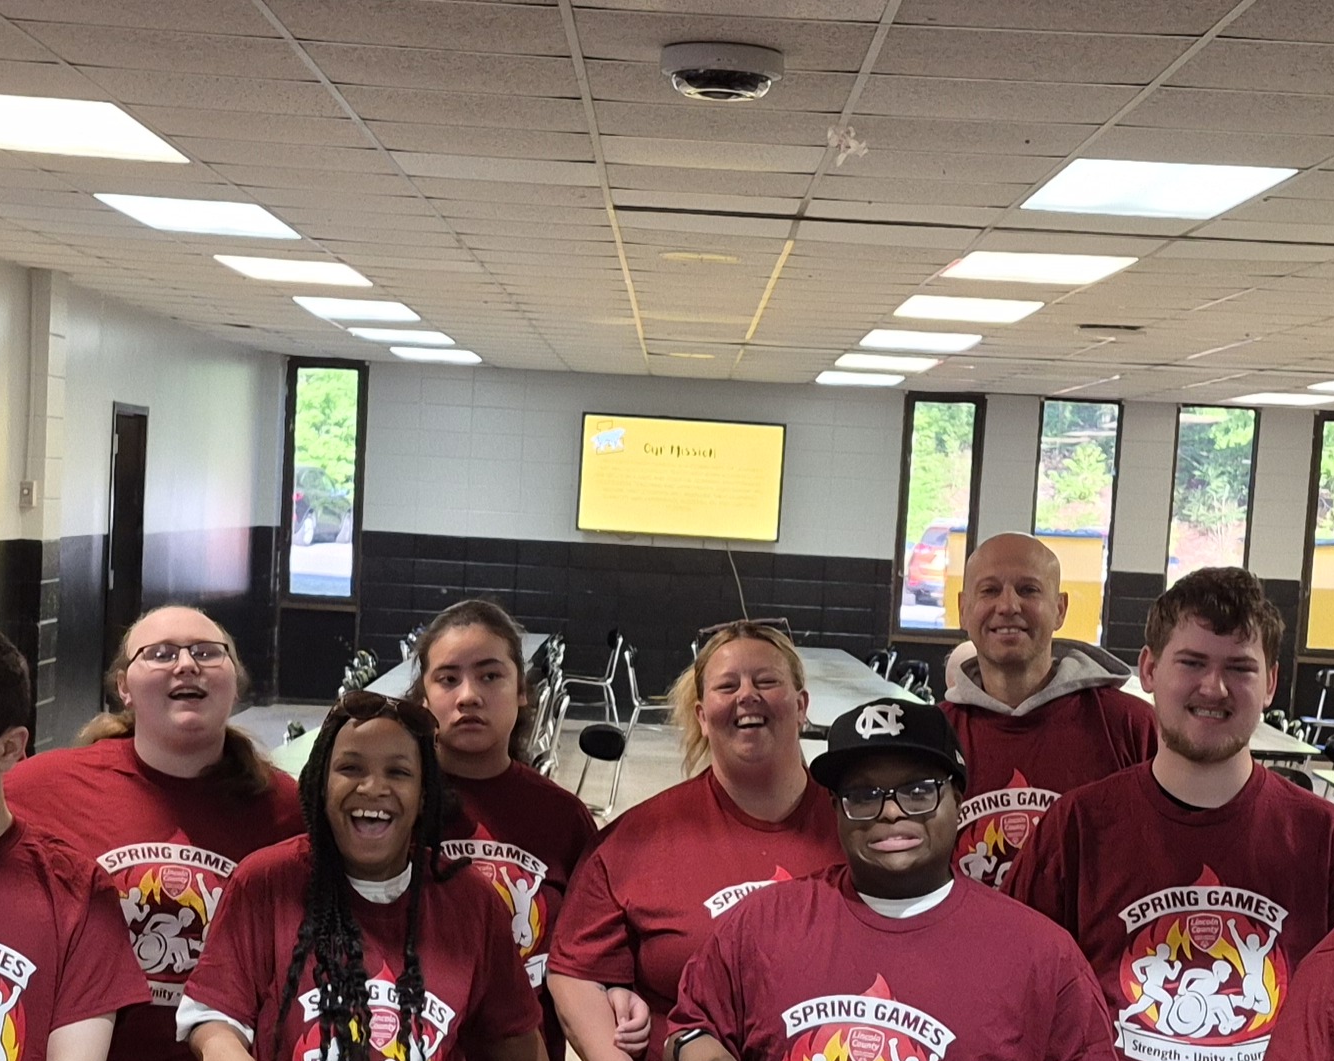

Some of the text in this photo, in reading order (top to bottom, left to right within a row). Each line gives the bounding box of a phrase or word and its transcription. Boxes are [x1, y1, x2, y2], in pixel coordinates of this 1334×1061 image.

[644, 442, 717, 459] Our Mission
[1017, 791, 1055, 808] GAM
[105, 846, 233, 874] SPRING GAME
[441, 842, 476, 857] ING
[482, 843, 541, 872] GAMES
[712, 885, 763, 910] SPRI
[1127, 890, 1279, 924] SPRING GAMES
[149, 986, 174, 1001] nity
[789, 999, 946, 1046] SPRING GAMES
[1132, 1039, 1181, 1061] Strength
